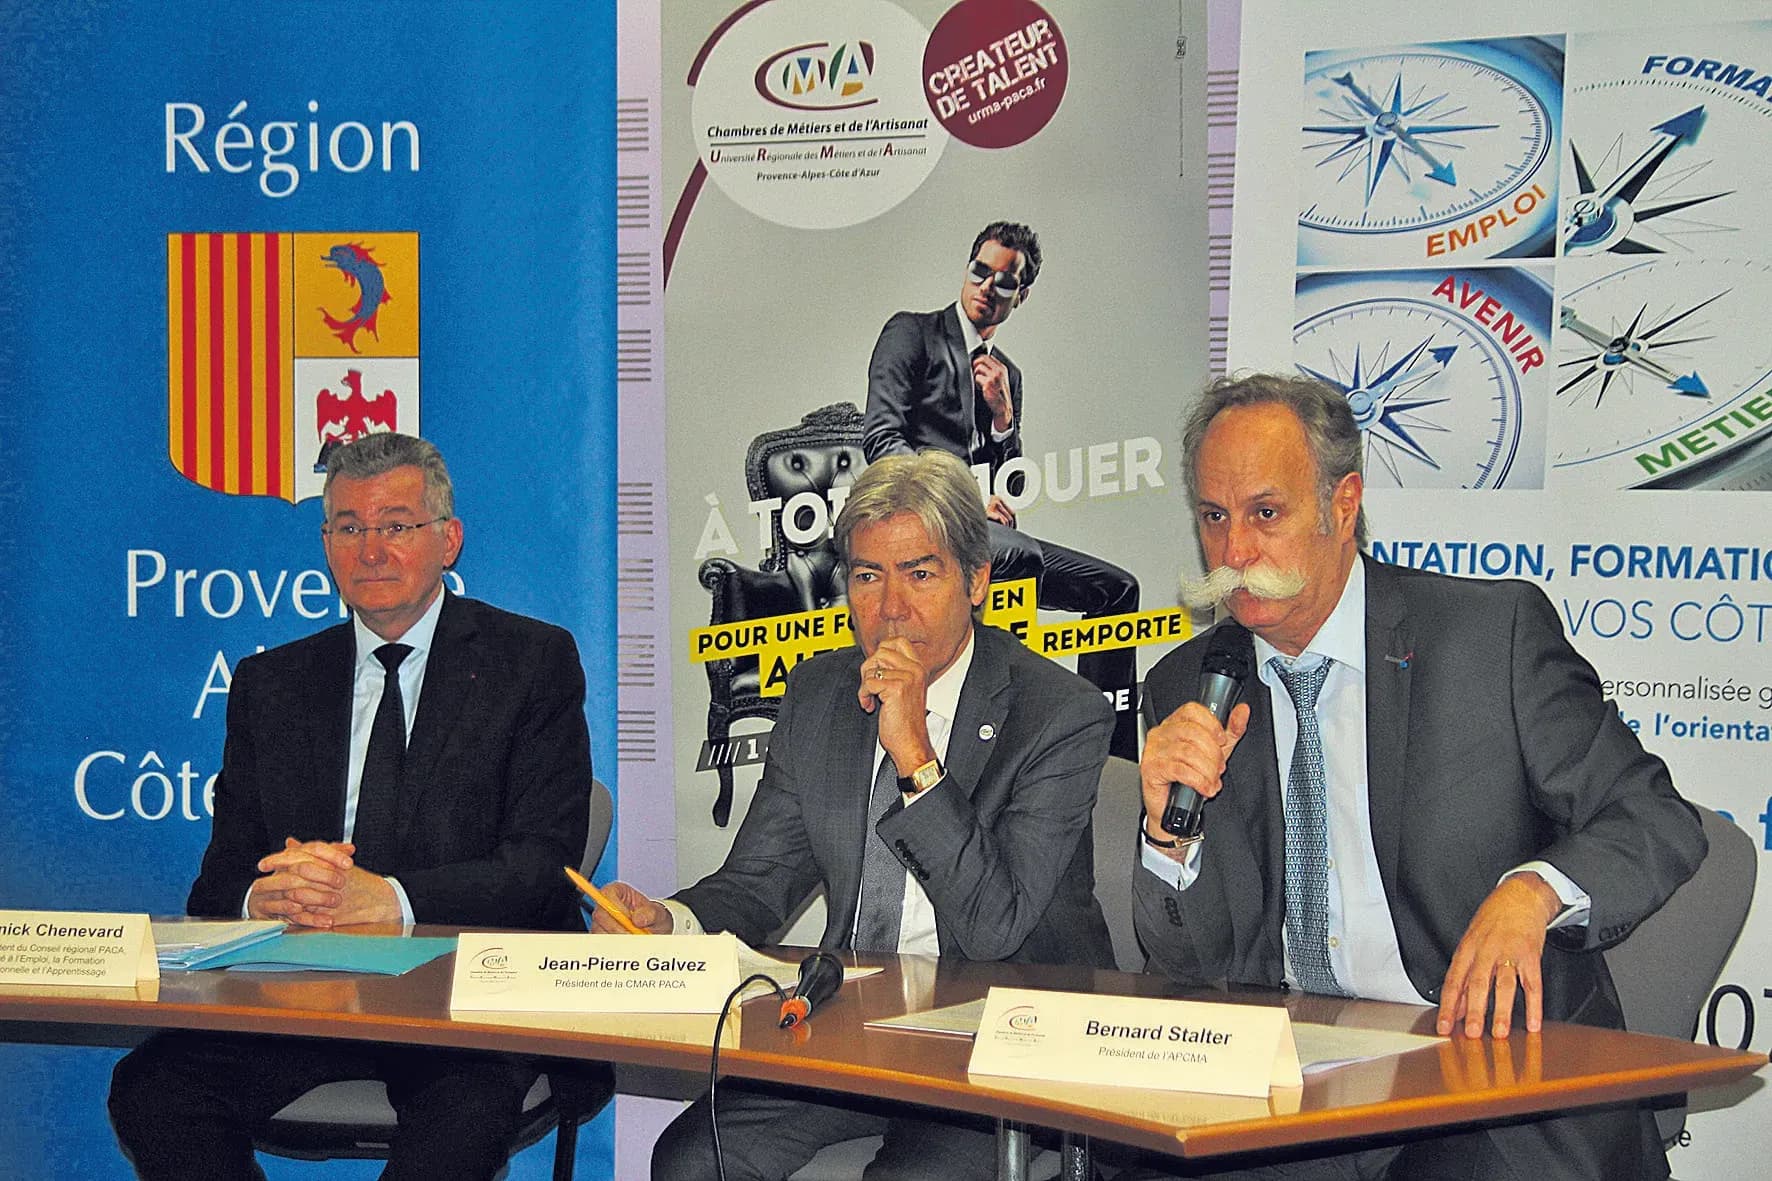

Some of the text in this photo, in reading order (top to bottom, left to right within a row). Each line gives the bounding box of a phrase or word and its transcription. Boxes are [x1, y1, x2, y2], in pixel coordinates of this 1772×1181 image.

[929, 19, 1053, 95] CREATEUR
[936, 41, 1058, 120] DE TALENT
[1642, 55, 1772, 103] FORMA
[968, 77, 1046, 125] urma-paca.fr
[707, 118, 928, 138] Chambres de Métiers et de l'Artisanat
[165, 100, 420, 198] Région
[710, 149, 755, 164] Université
[757, 147, 803, 162] Régionale
[804, 151, 819, 161] des
[819, 145, 857, 160] Métiers
[857, 148, 866, 158] et
[867, 147, 879, 158] de
[851, 168, 881, 177] d'Azur
[1425, 183, 1547, 258] EMPLOI
[1432, 275, 1546, 375] AVENIR
[1634, 388, 1772, 476] METIE
[694, 492, 739, 560] À
[1570, 544, 1772, 581] FORMATI
[992, 587, 1024, 611] EN
[1043, 613, 1181, 653] REMPORTE
[1563, 599, 1653, 638] VOS
[699, 625, 768, 655] POUR
[776, 616, 825, 642] UNE
[1654, 712, 1772, 742] l'orienta
[36, 924, 124, 938] Chenevard
[17, 944, 28, 952] du
[30, 944, 60, 953] Conseil
[63, 945, 97, 955] régional
[98, 946, 124, 954] PACA
[63, 956, 105, 965] Formation
[538, 957, 706, 971] Jean-Pierre Galvez
[41, 967, 107, 977] l'Apprentissage
[555, 979, 686, 988] Président de la CMAR PACA
[1086, 1020, 1233, 1045] Bernard Stalter
[1098, 1047, 1145, 1060] Président
[1147, 1051, 1160, 1060] de
